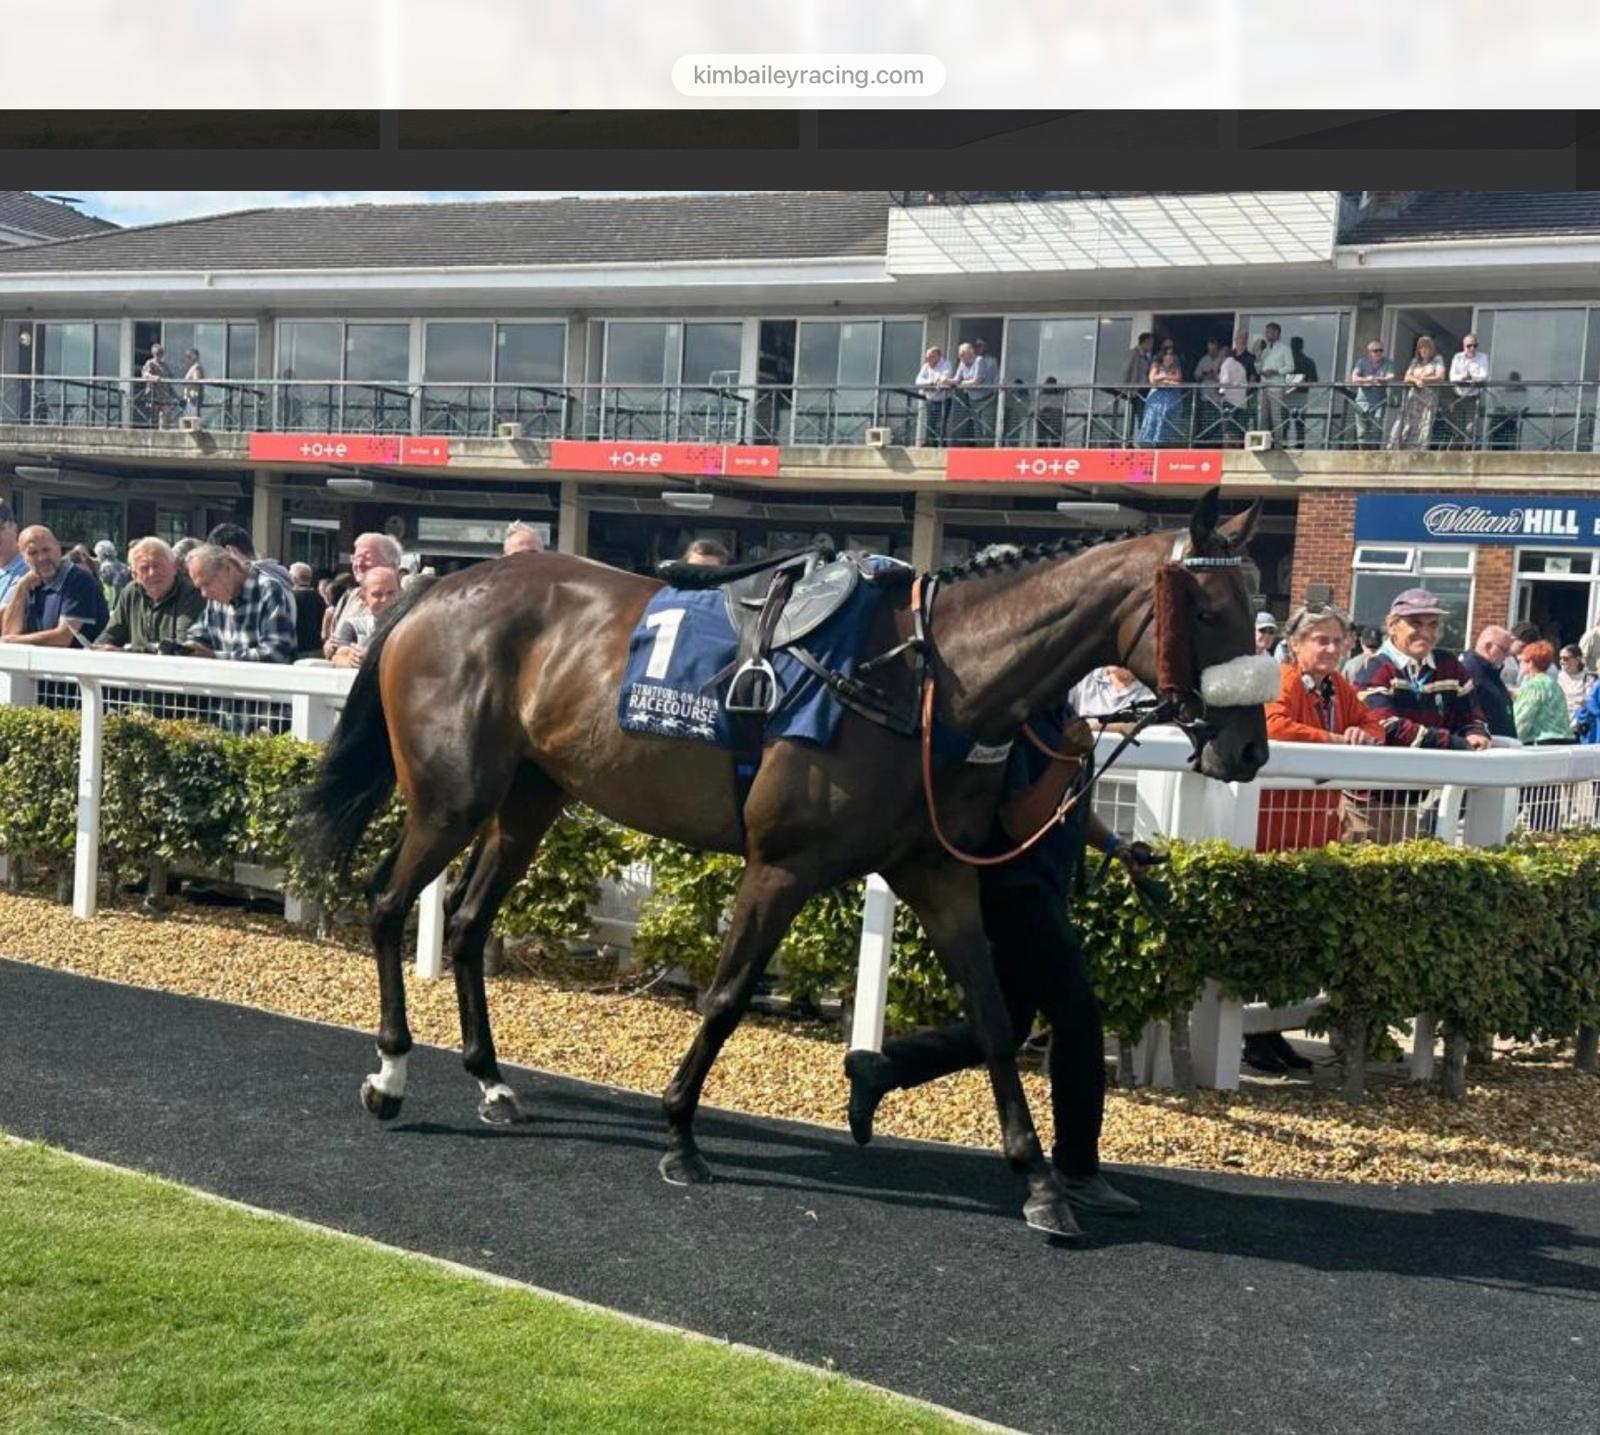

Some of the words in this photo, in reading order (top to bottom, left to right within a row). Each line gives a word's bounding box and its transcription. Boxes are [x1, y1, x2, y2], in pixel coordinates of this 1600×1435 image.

[1423, 503, 1524, 536] William
[1522, 508, 1579, 535] HILL
[645, 607, 687, 680] 1
[629, 694, 718, 724] RACECOURSE
